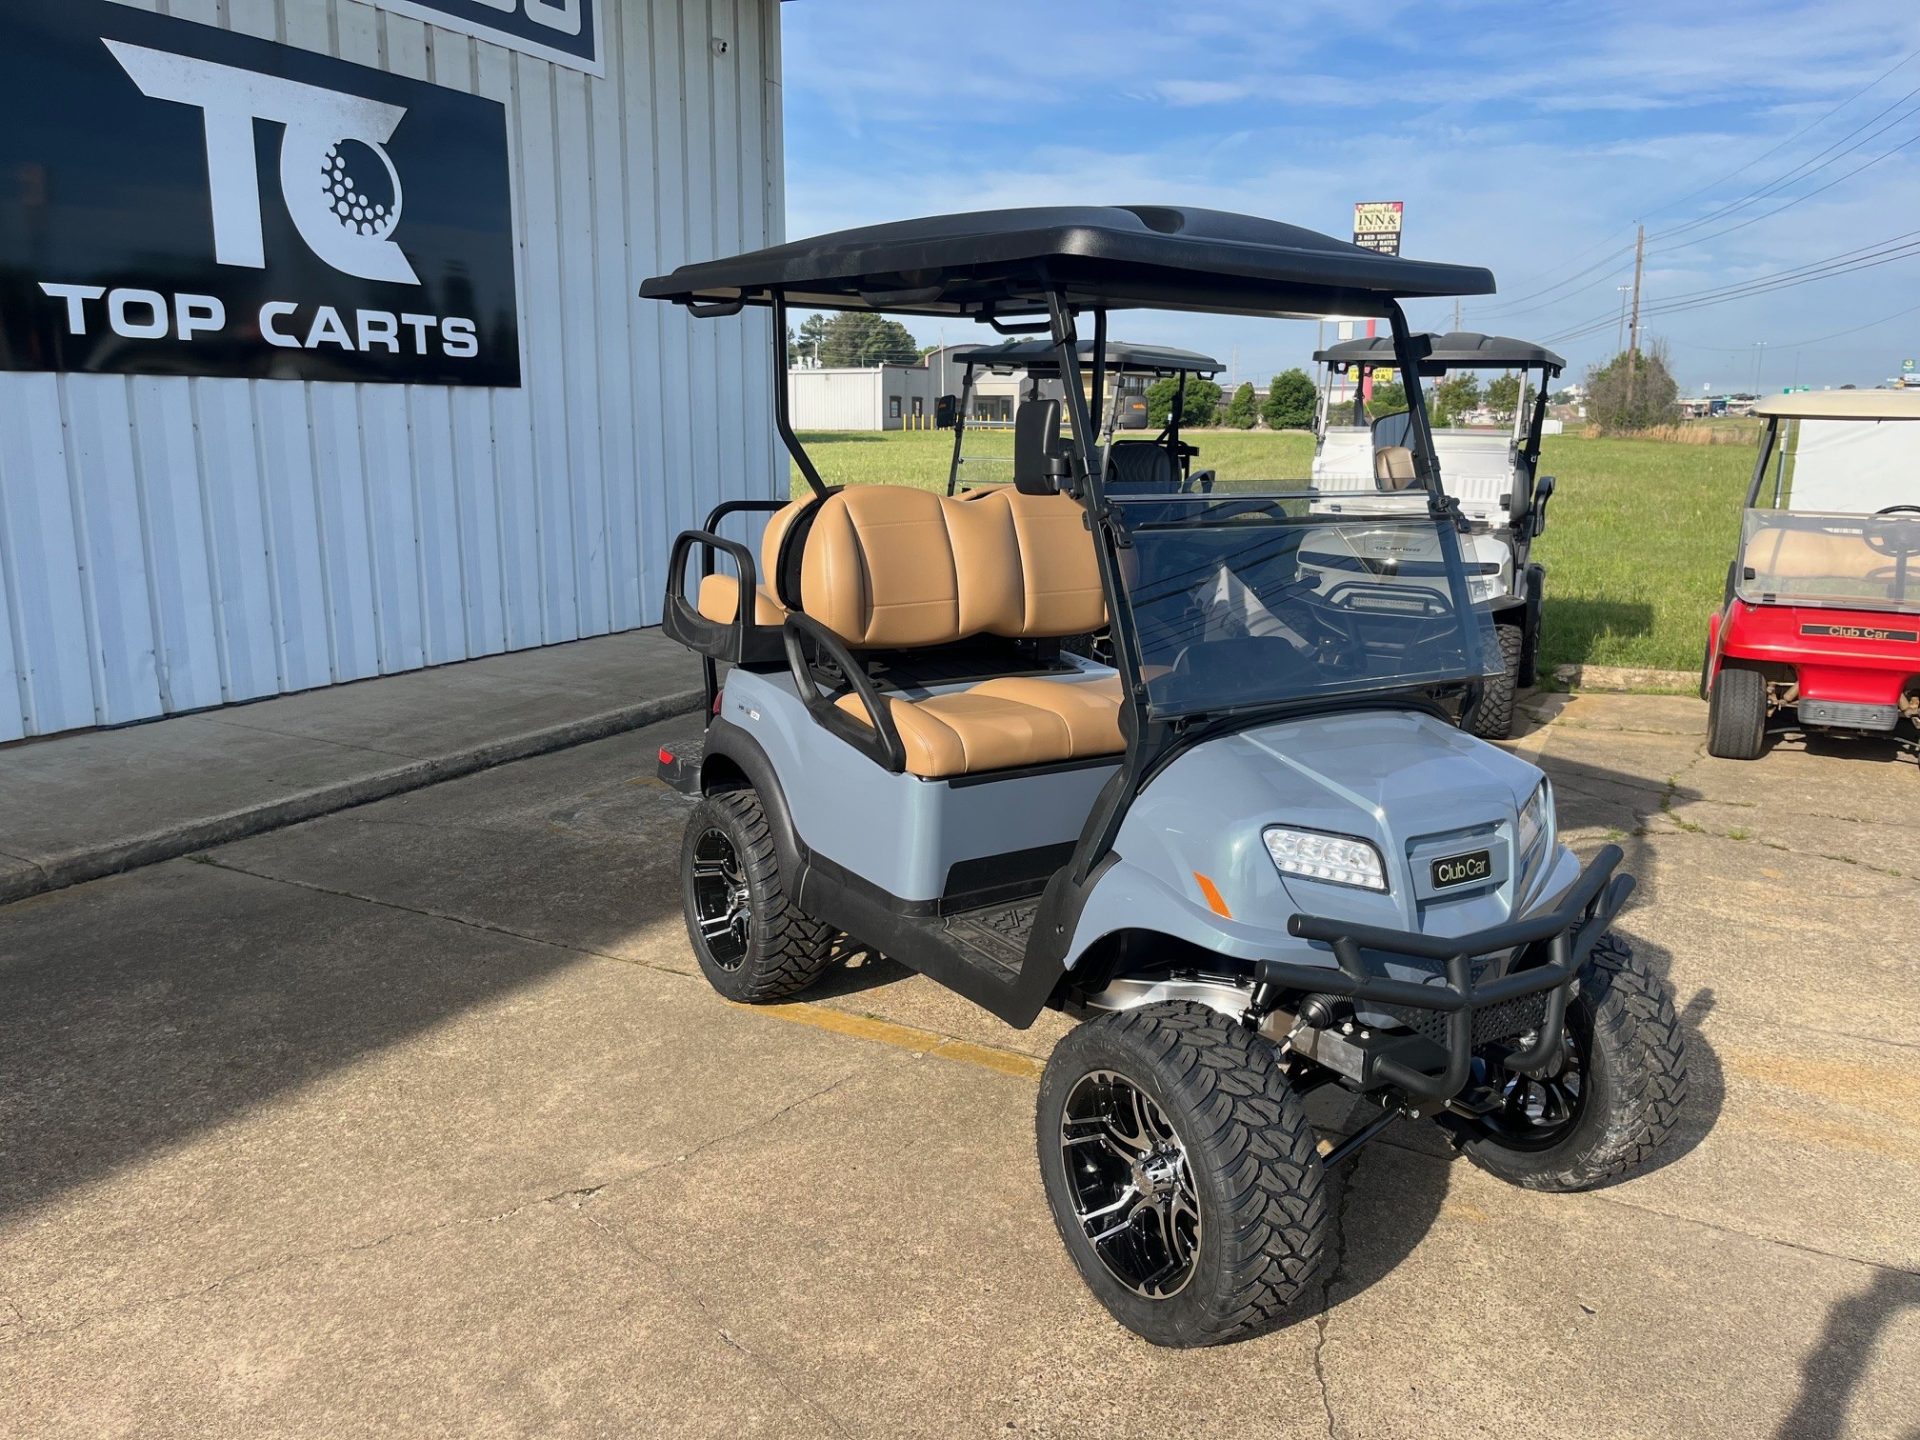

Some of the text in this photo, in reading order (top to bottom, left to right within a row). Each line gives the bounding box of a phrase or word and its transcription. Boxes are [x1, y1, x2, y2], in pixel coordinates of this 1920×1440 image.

[1358, 214, 1397, 226] INN &
[38, 282, 479, 358] TOP CARTS
[1829, 626, 1889, 639] Club Car
[1438, 858, 1486, 882] Club Car
